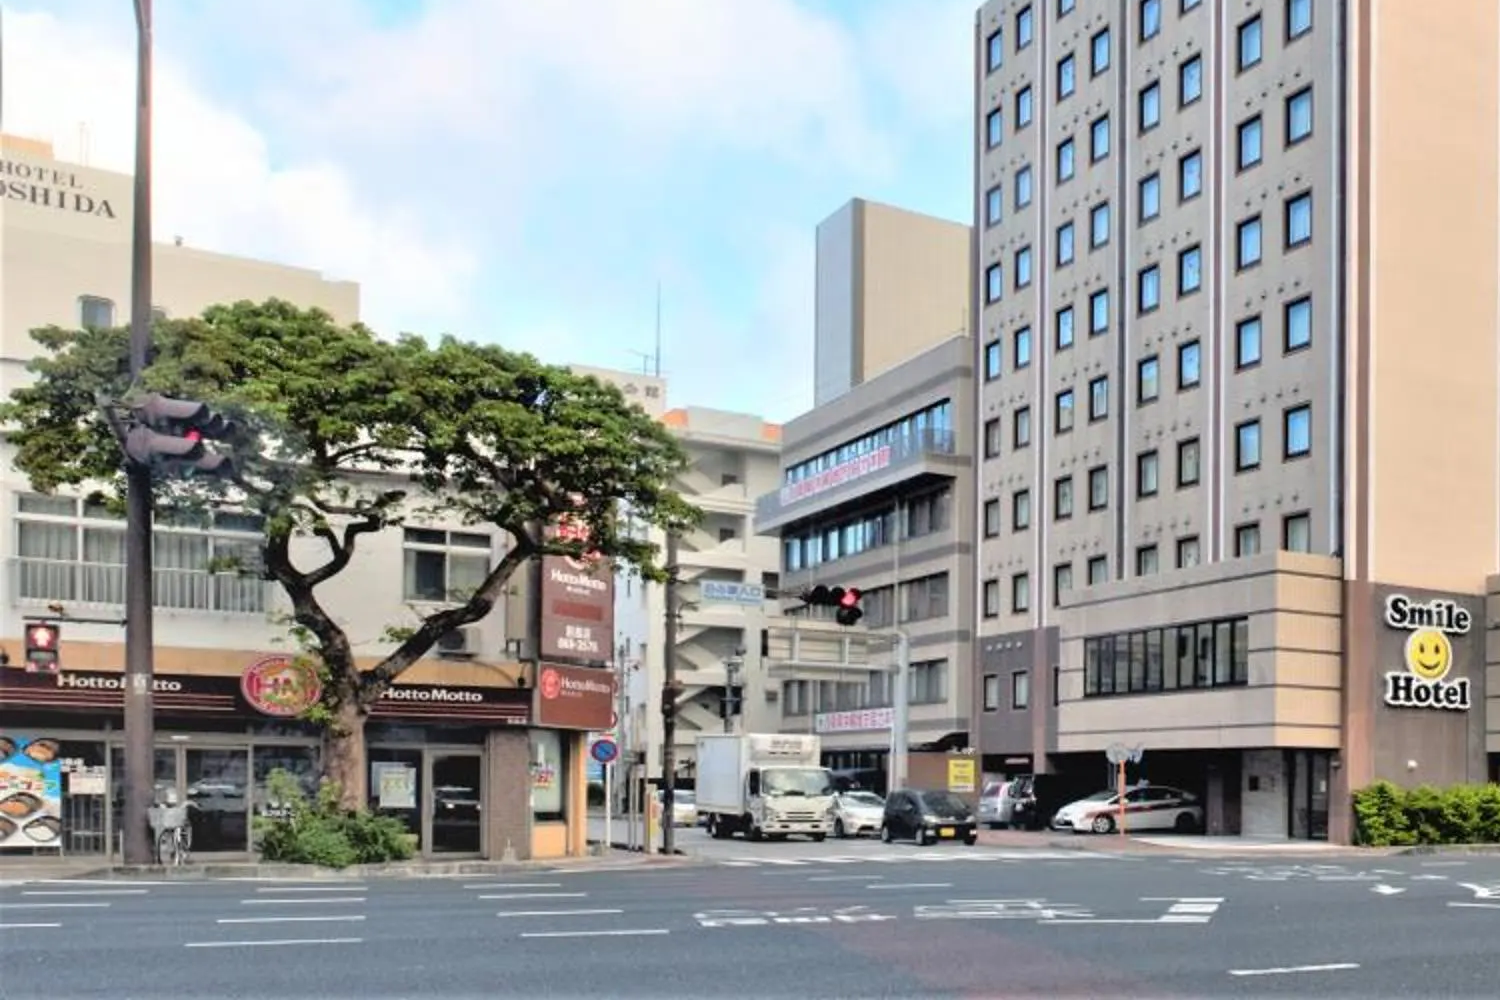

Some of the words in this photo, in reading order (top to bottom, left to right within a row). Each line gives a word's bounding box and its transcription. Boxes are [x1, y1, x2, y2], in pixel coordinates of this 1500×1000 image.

[0, 160, 84, 189] HOTEL
[1387, 596, 1471, 633] Smile
[57, 673, 182, 692] Hottotto
[1386, 673, 1471, 708] Hotel
